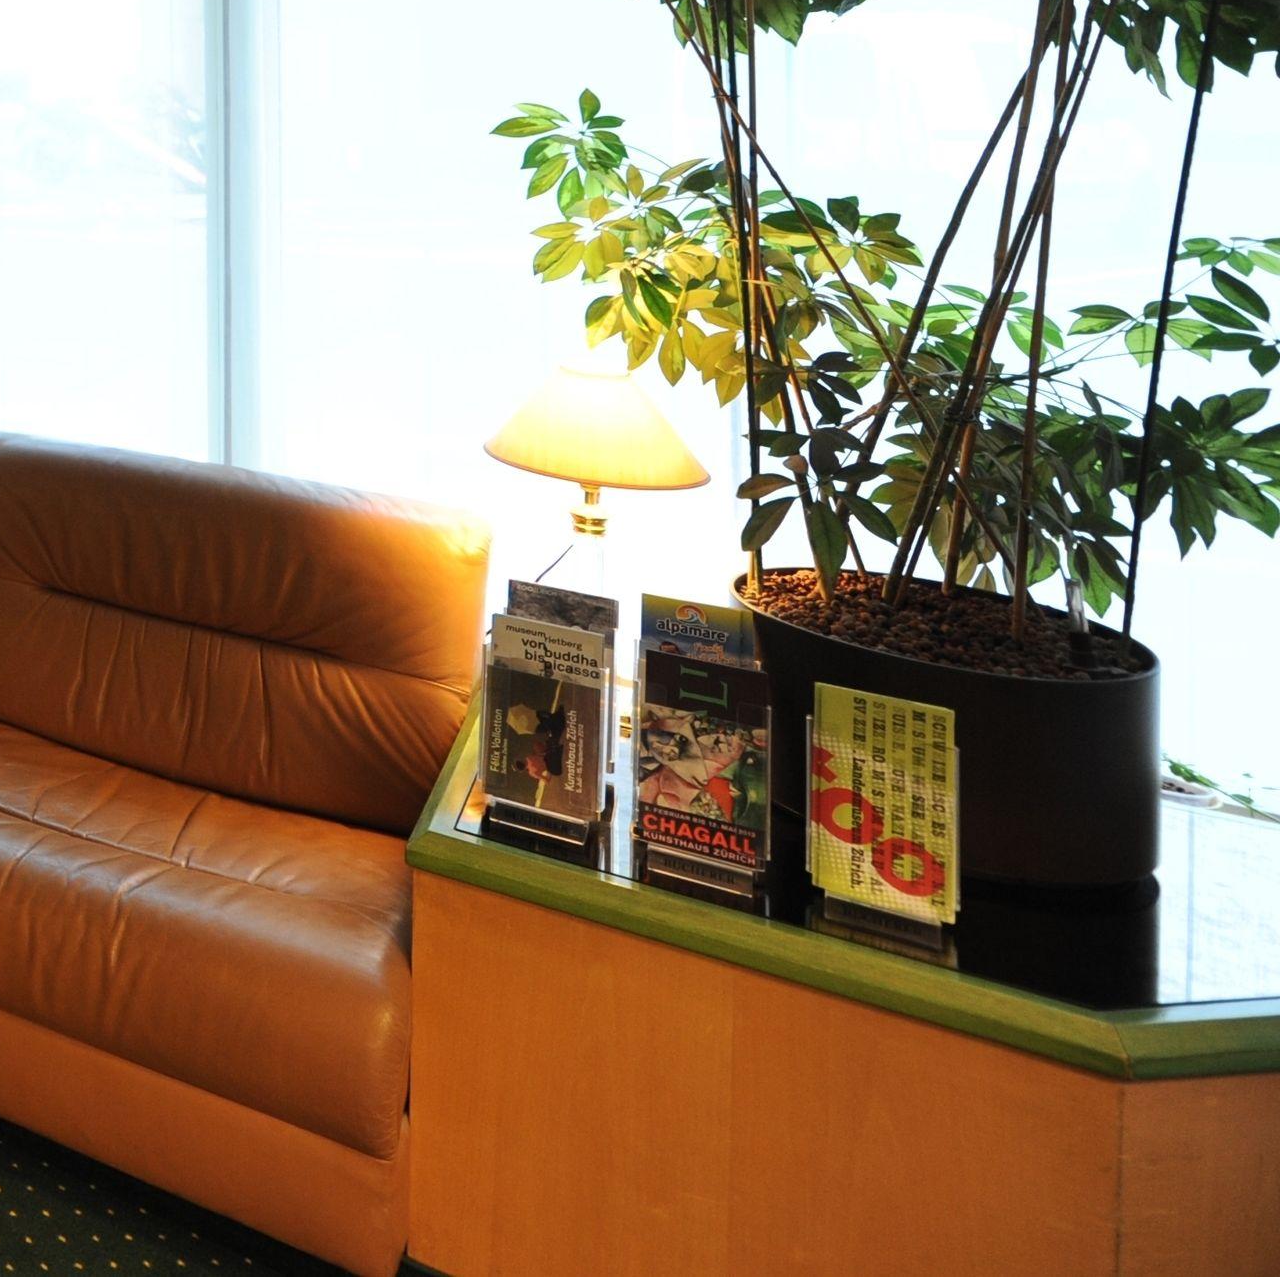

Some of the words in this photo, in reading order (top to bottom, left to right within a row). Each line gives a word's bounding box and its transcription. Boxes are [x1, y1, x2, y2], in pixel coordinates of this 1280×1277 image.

[505, 624, 546, 638] museum
[545, 636, 583, 651] rietberg
[657, 618, 727, 642] alpamare
[521, 638, 545, 650] von
[544, 648, 598, 668] buddha
[525, 649, 544, 662] bis
[566, 710, 577, 740] Zürich
[564, 742, 576, 792] Kunsthaus
[851, 757, 866, 844] Landesmuseum
[653, 807, 691, 821] FEBRUAR
[692, 816, 706, 825] BIS
[642, 813, 756, 855] CHAGALL
[643, 830, 710, 854] KUNSTHAUS
[713, 846, 757, 866] ZÜRICH
[850, 847, 866, 889] Zürich.
